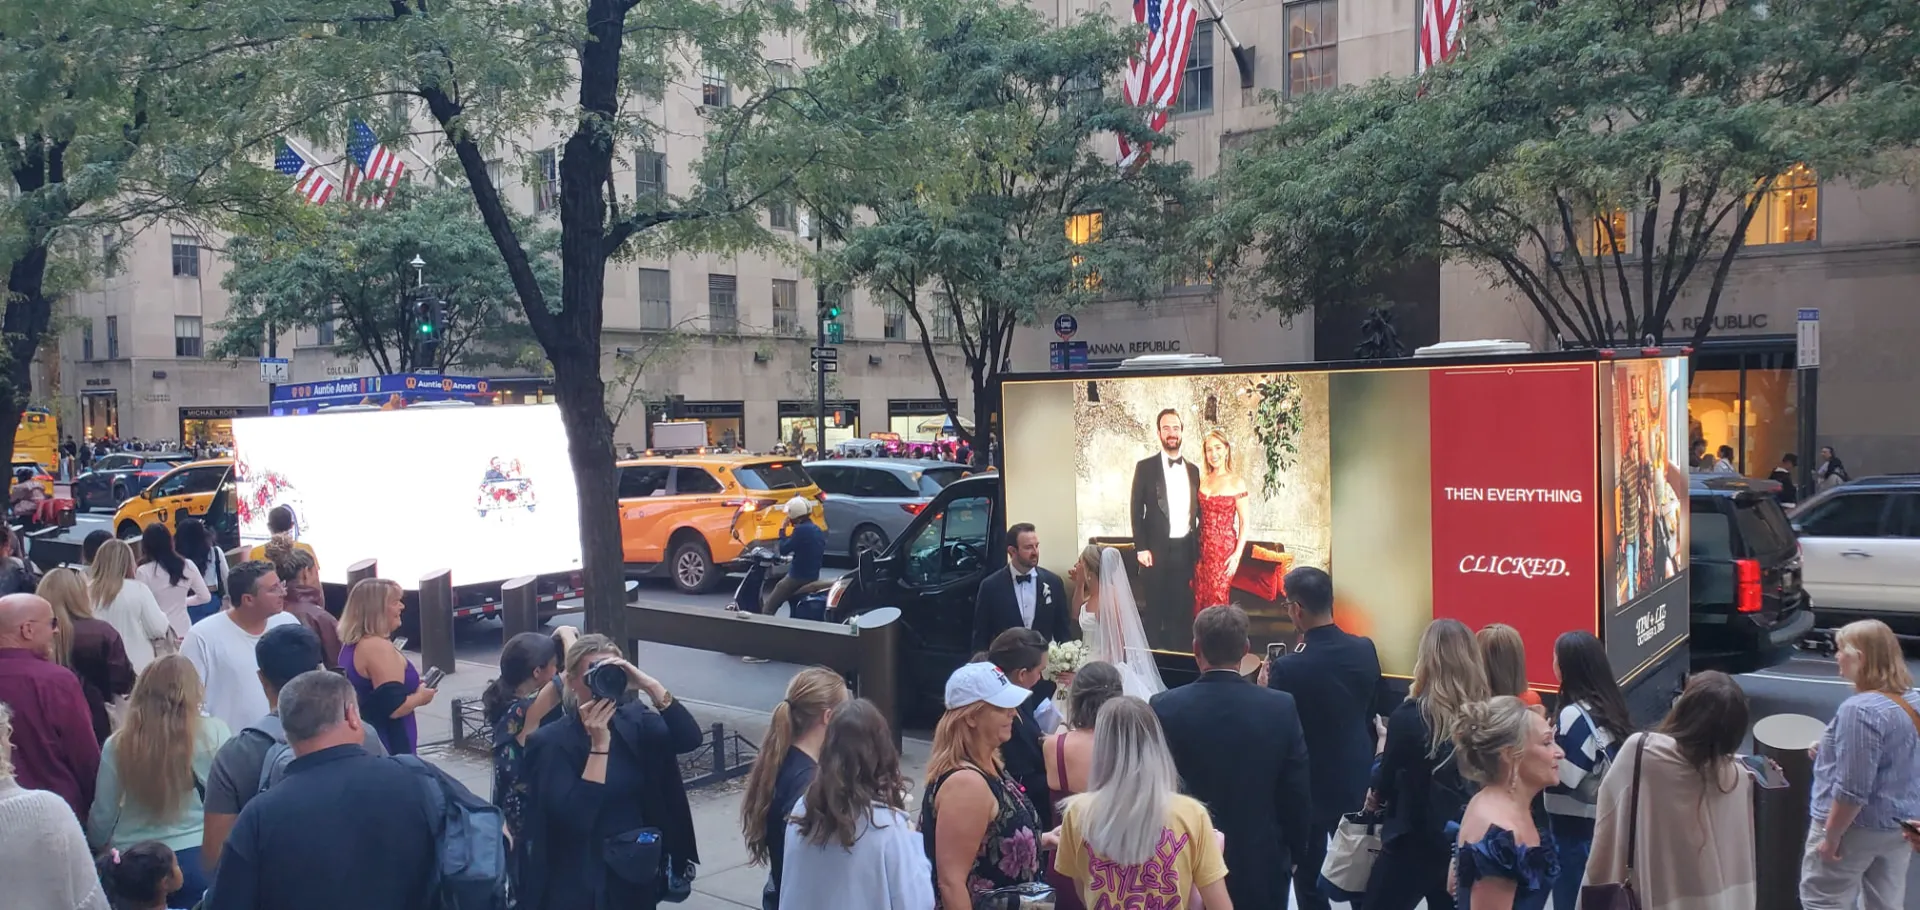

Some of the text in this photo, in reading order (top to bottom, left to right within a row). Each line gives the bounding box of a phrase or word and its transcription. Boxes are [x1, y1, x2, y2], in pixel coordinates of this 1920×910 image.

[1682, 314, 1768, 330] REUBLIC
[1086, 340, 1180, 355] ANANA REPUBLIC
[313, 381, 358, 395] Auntie Anne's
[418, 380, 476, 391] Auntie Anne's
[187, 408, 217, 416] MICHAEL
[1444, 487, 1582, 503] THEN EVERYTHING
[1459, 555, 1570, 579] CLICKED.
[1089, 859, 1179, 901] STYLES
